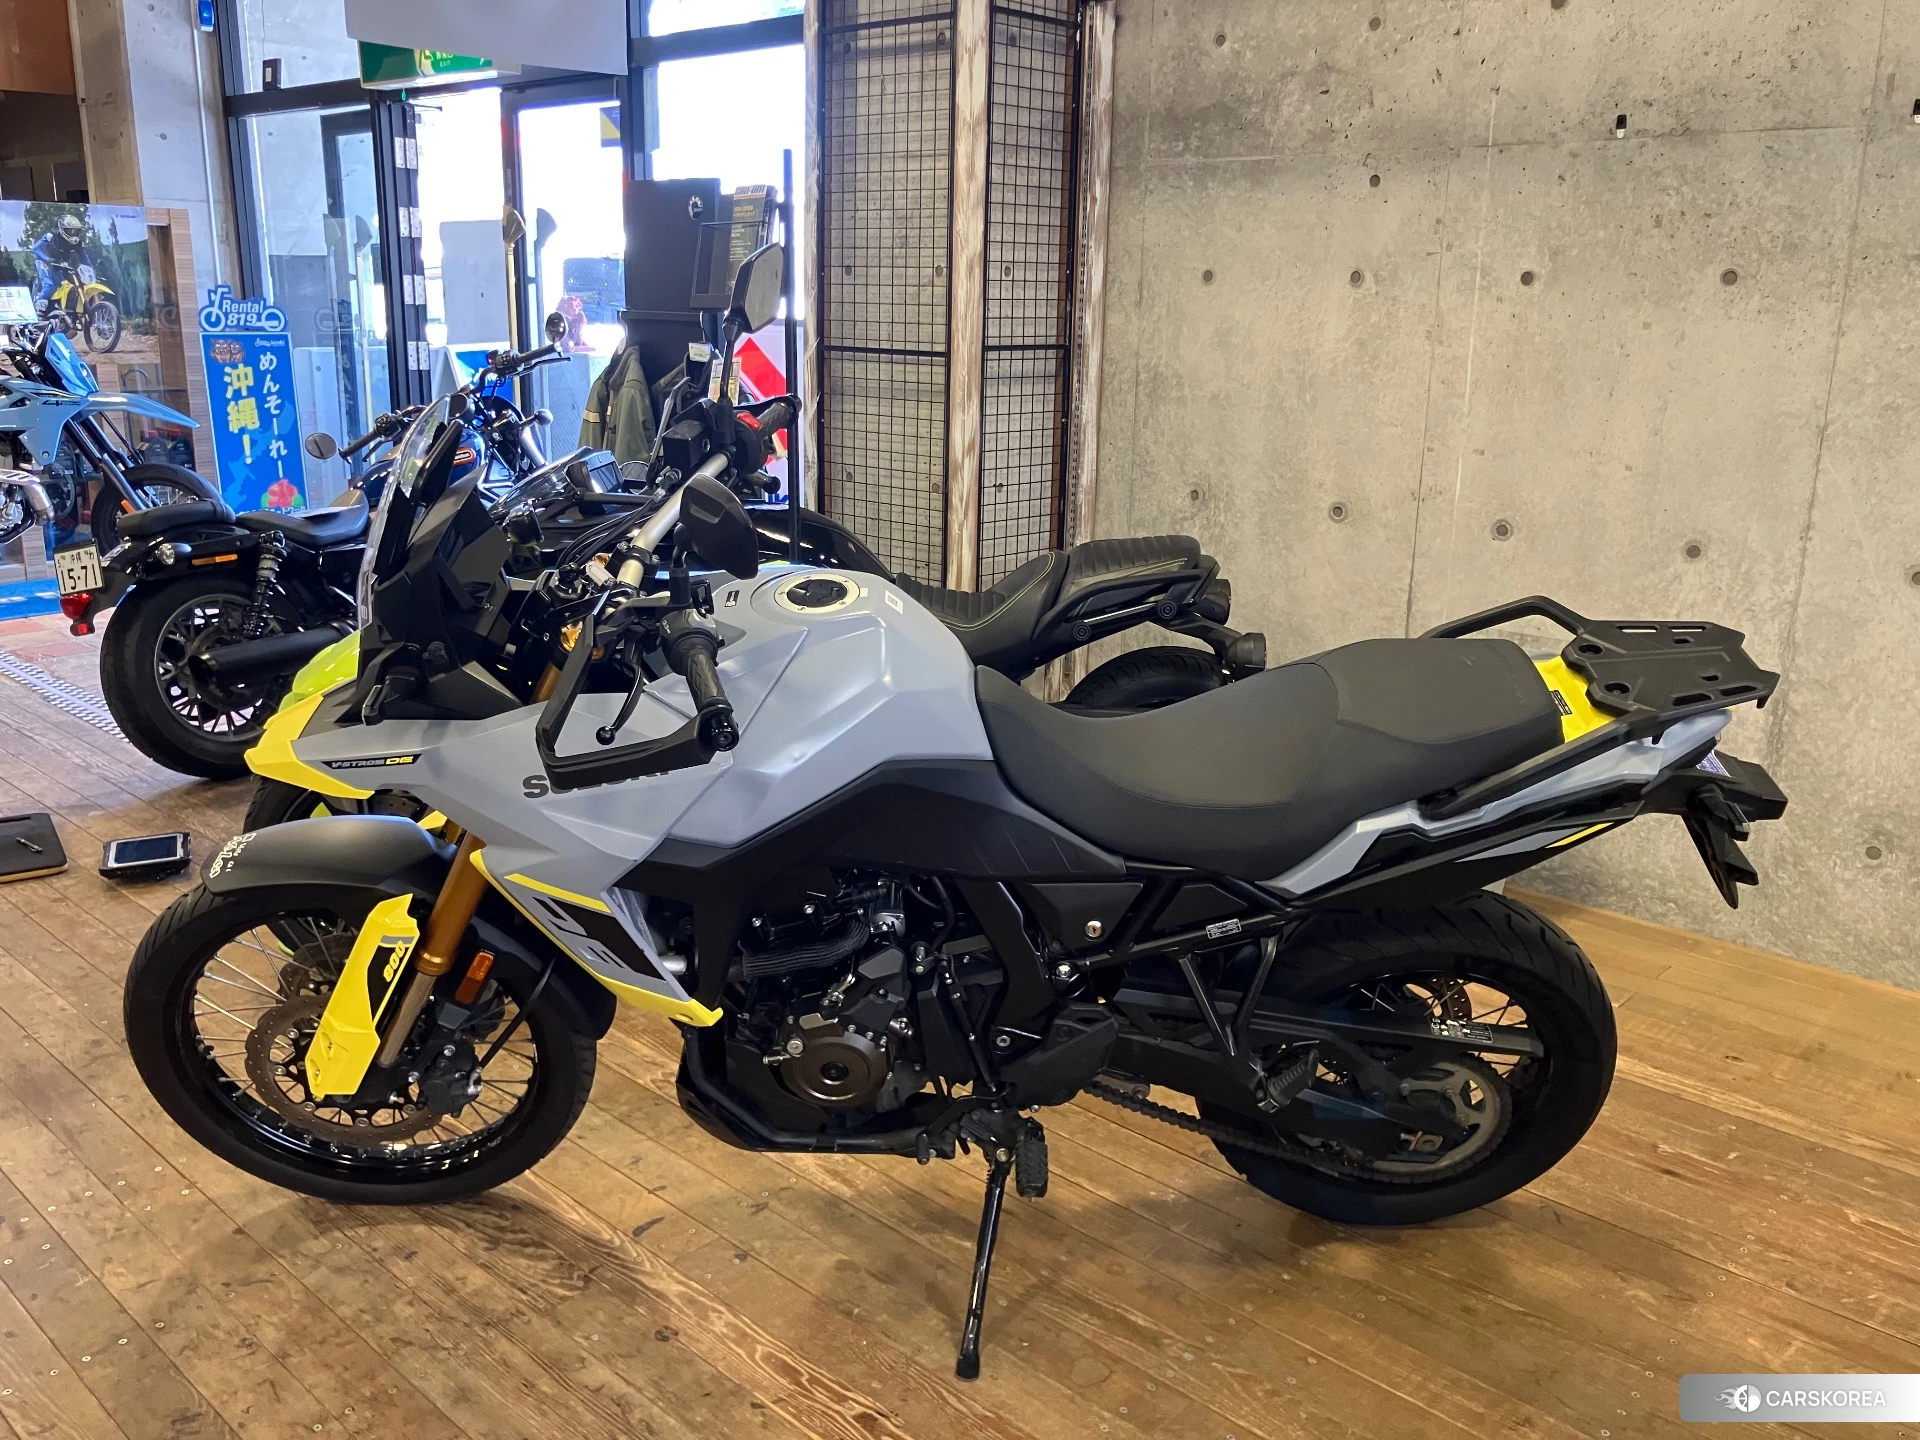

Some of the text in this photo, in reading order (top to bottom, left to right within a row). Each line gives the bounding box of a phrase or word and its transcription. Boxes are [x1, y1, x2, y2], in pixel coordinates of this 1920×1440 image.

[222, 299, 265, 313] Rental
[226, 312, 258, 326] 819
[223, 363, 260, 465] 沖縄!
[259, 351, 288, 479] めんそーれー
[383, 939, 406, 983] 800
